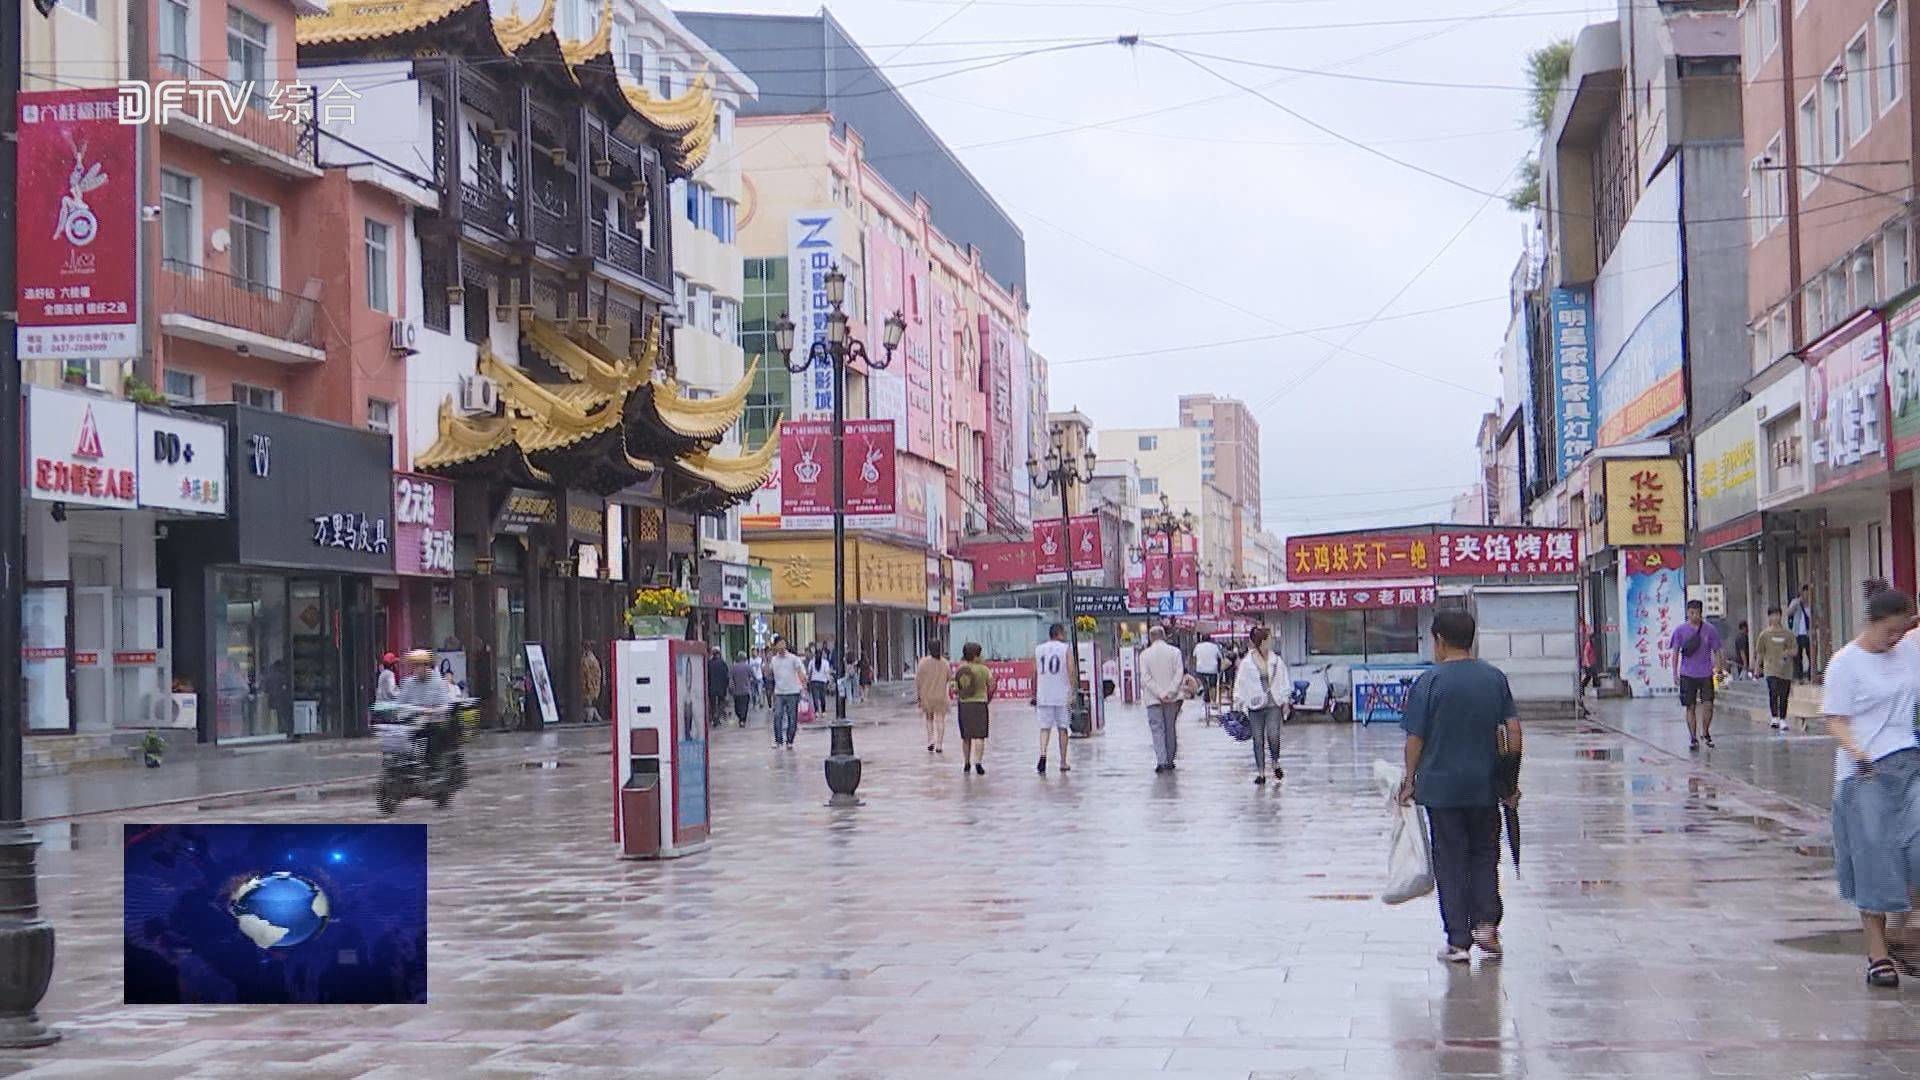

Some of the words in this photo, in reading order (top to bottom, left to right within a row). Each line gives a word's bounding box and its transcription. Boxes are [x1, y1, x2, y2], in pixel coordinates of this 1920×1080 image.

[36, 458, 135, 500] 足力健老人鞋
[1629, 470, 1664, 535] 化妆品
[314, 513, 388, 554] 万里马皮具
[1454, 533, 1573, 561] 夹馅烤馍
[1295, 540, 1428, 573] 大鸡块天下一绝
[1288, 591, 1347, 608] 买好钻
[1377, 588, 1434, 605] 老凤祥
[1040, 655, 1060, 674] 10
